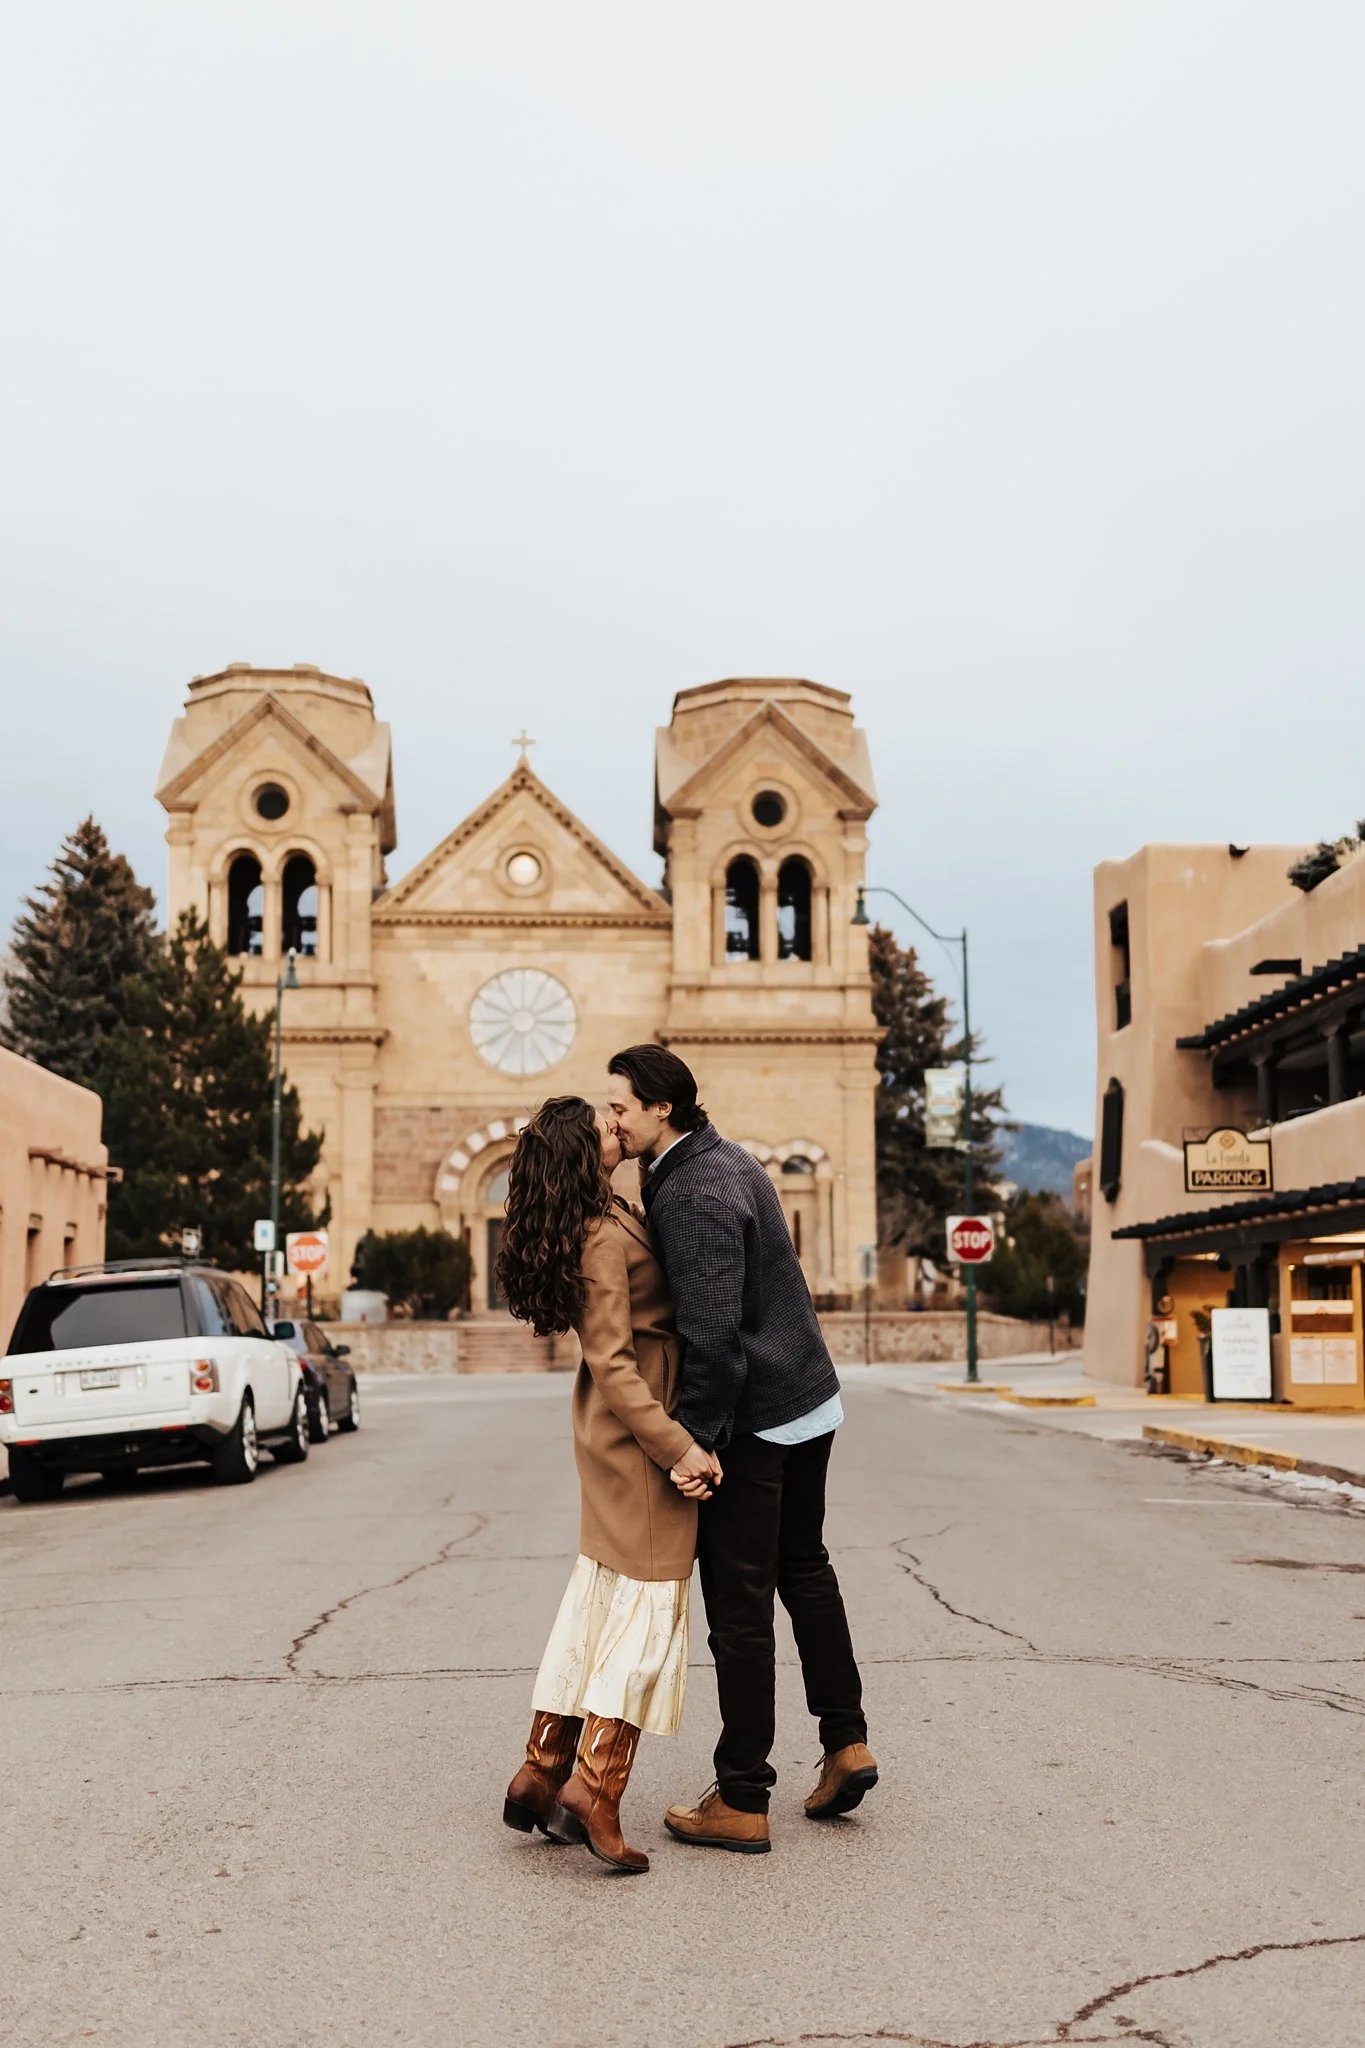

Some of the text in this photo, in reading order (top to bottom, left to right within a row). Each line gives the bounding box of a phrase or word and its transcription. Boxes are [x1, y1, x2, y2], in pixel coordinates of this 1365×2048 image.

[1205, 1150, 1217, 1164] La
[1194, 1170, 1262, 1186] PARKING
[952, 1231, 991, 1250] STOP
[290, 1244, 325, 1262] STOP
